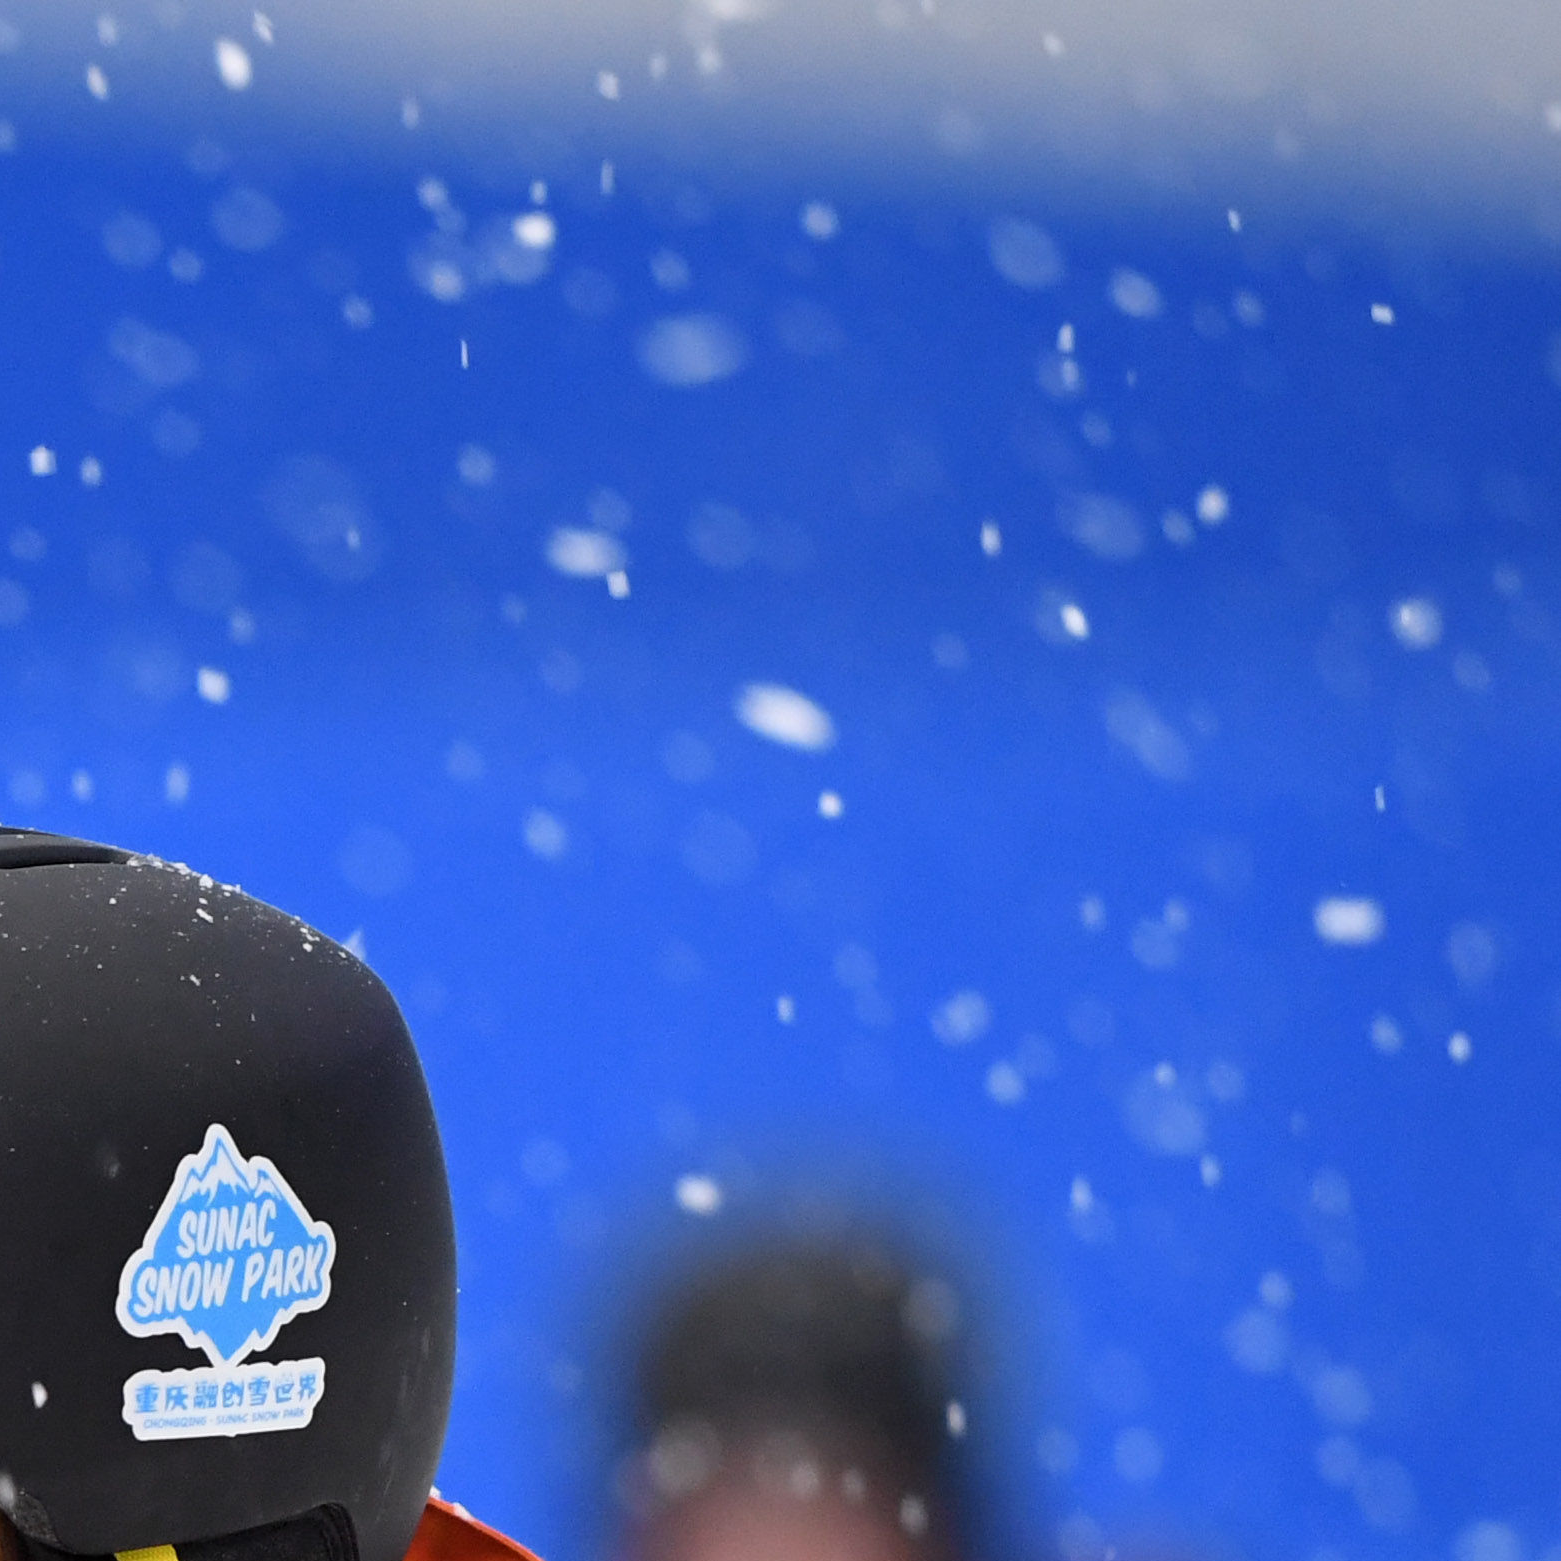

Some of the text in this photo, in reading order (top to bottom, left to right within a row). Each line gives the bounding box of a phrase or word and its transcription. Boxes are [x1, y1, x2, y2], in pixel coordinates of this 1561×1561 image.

[176, 1199, 277, 1258] SUNAC
[133, 1242, 324, 1318] SNOW PARK
[134, 1370, 318, 1413] 重庆融创雪世界
[143, 1406, 305, 1429] CHONGQING SUNAC SNOW PARK
